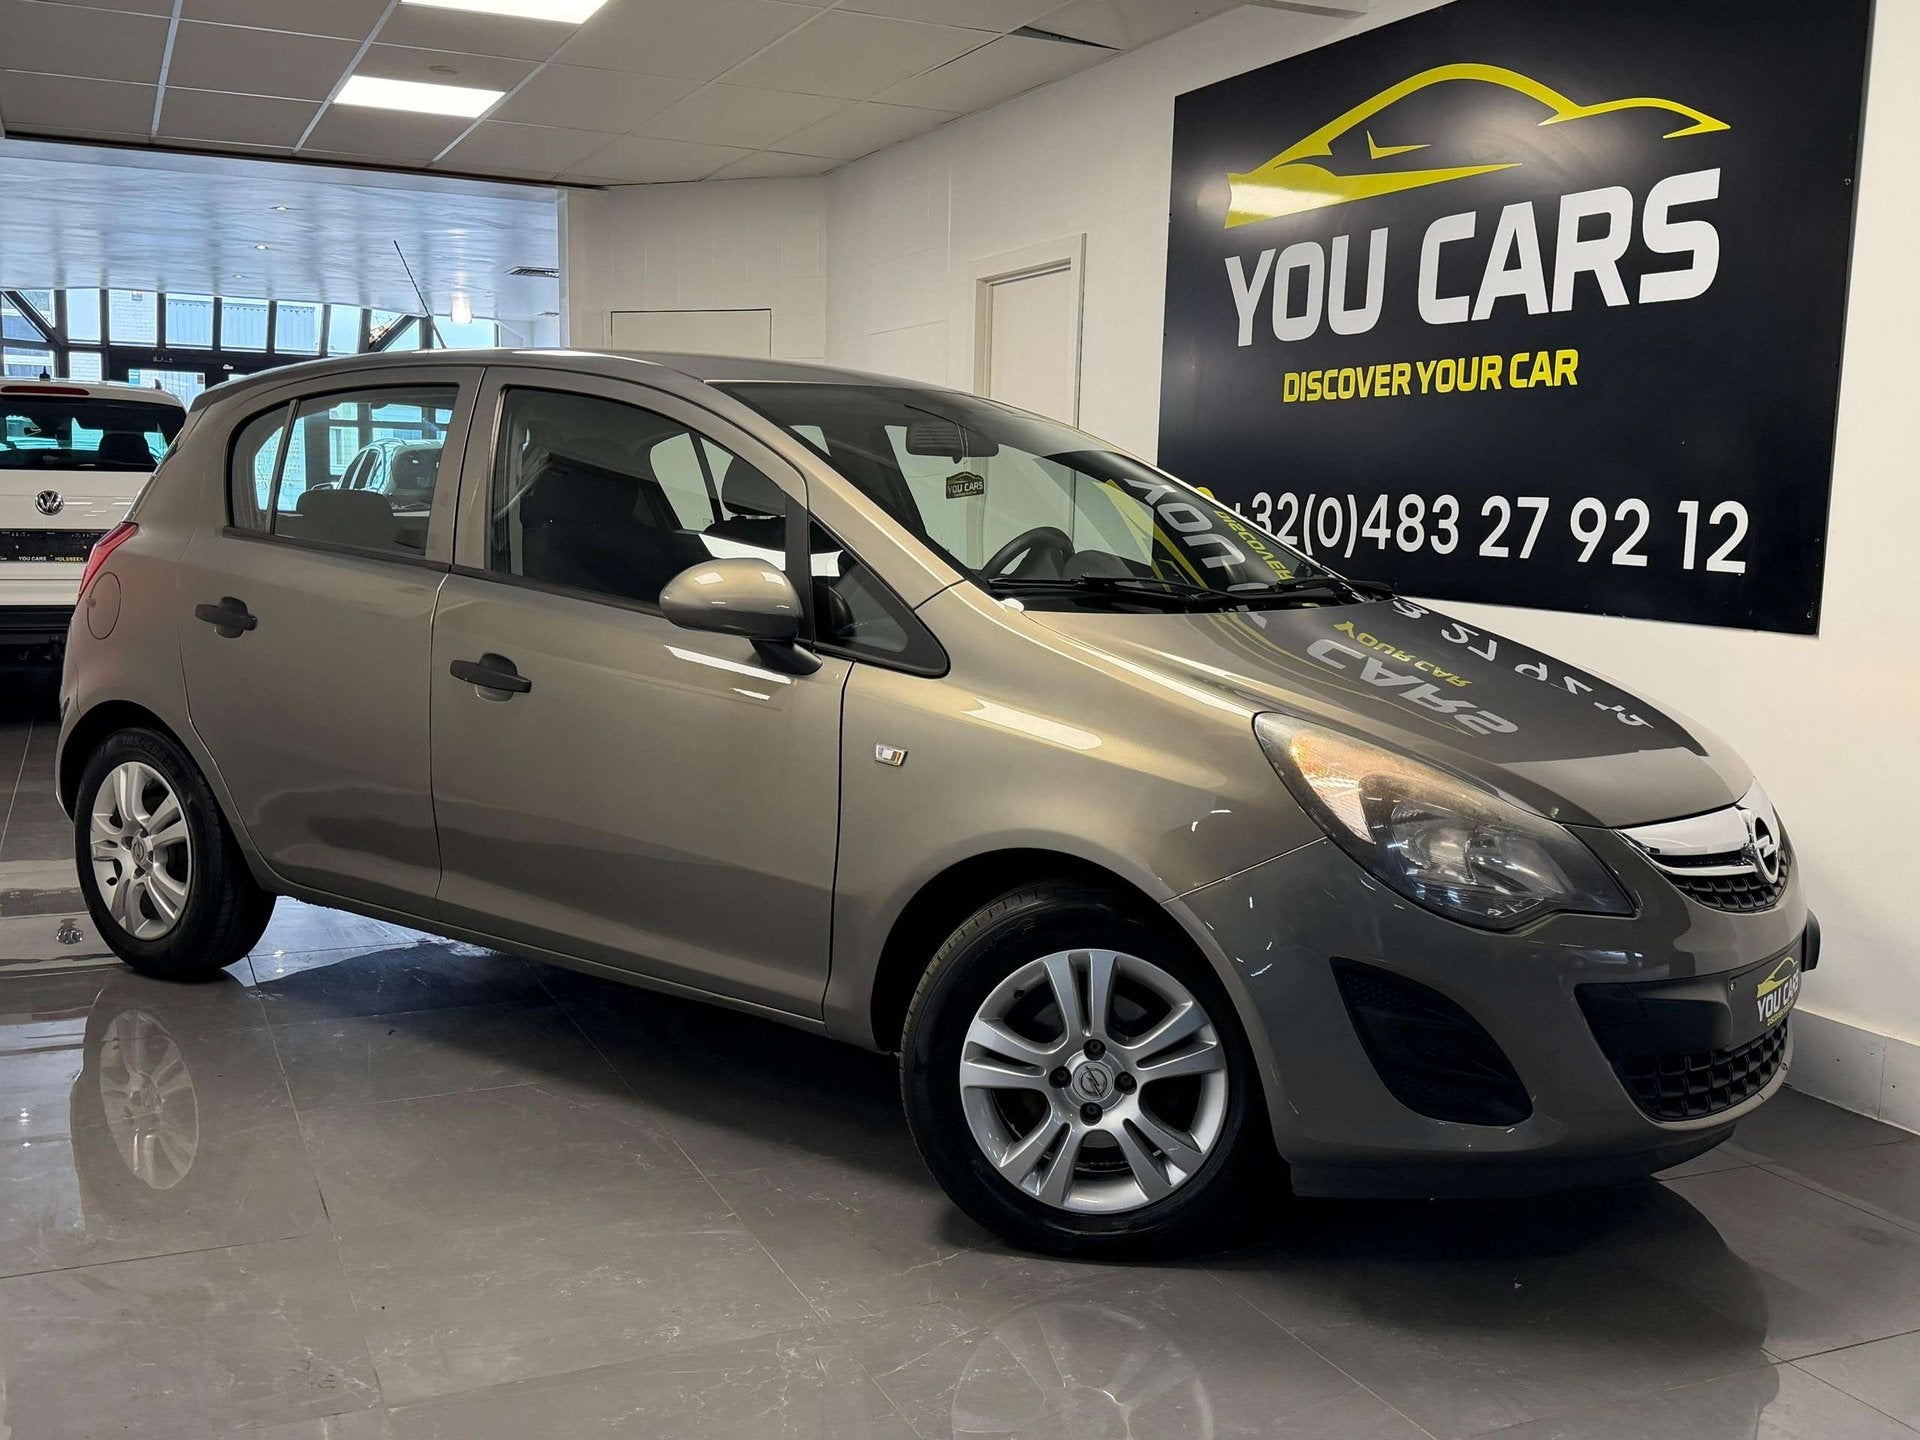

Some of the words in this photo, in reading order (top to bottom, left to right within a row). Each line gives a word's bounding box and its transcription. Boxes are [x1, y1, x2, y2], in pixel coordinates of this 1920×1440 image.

[1223, 227, 1389, 347] YOU
[1417, 168, 1721, 325] CARS
[1283, 362, 1411, 403] DISCOVER
[1416, 354, 1503, 394] YOUR
[1509, 349, 1579, 388] CAR
[947, 484, 963, 494] YOU
[964, 481, 983, 492] CARS
[1479, 497, 1550, 559] 27
[1570, 499, 1650, 569] 92
[1677, 500, 1750, 574] 12
[1757, 988, 1781, 1022] YOU
